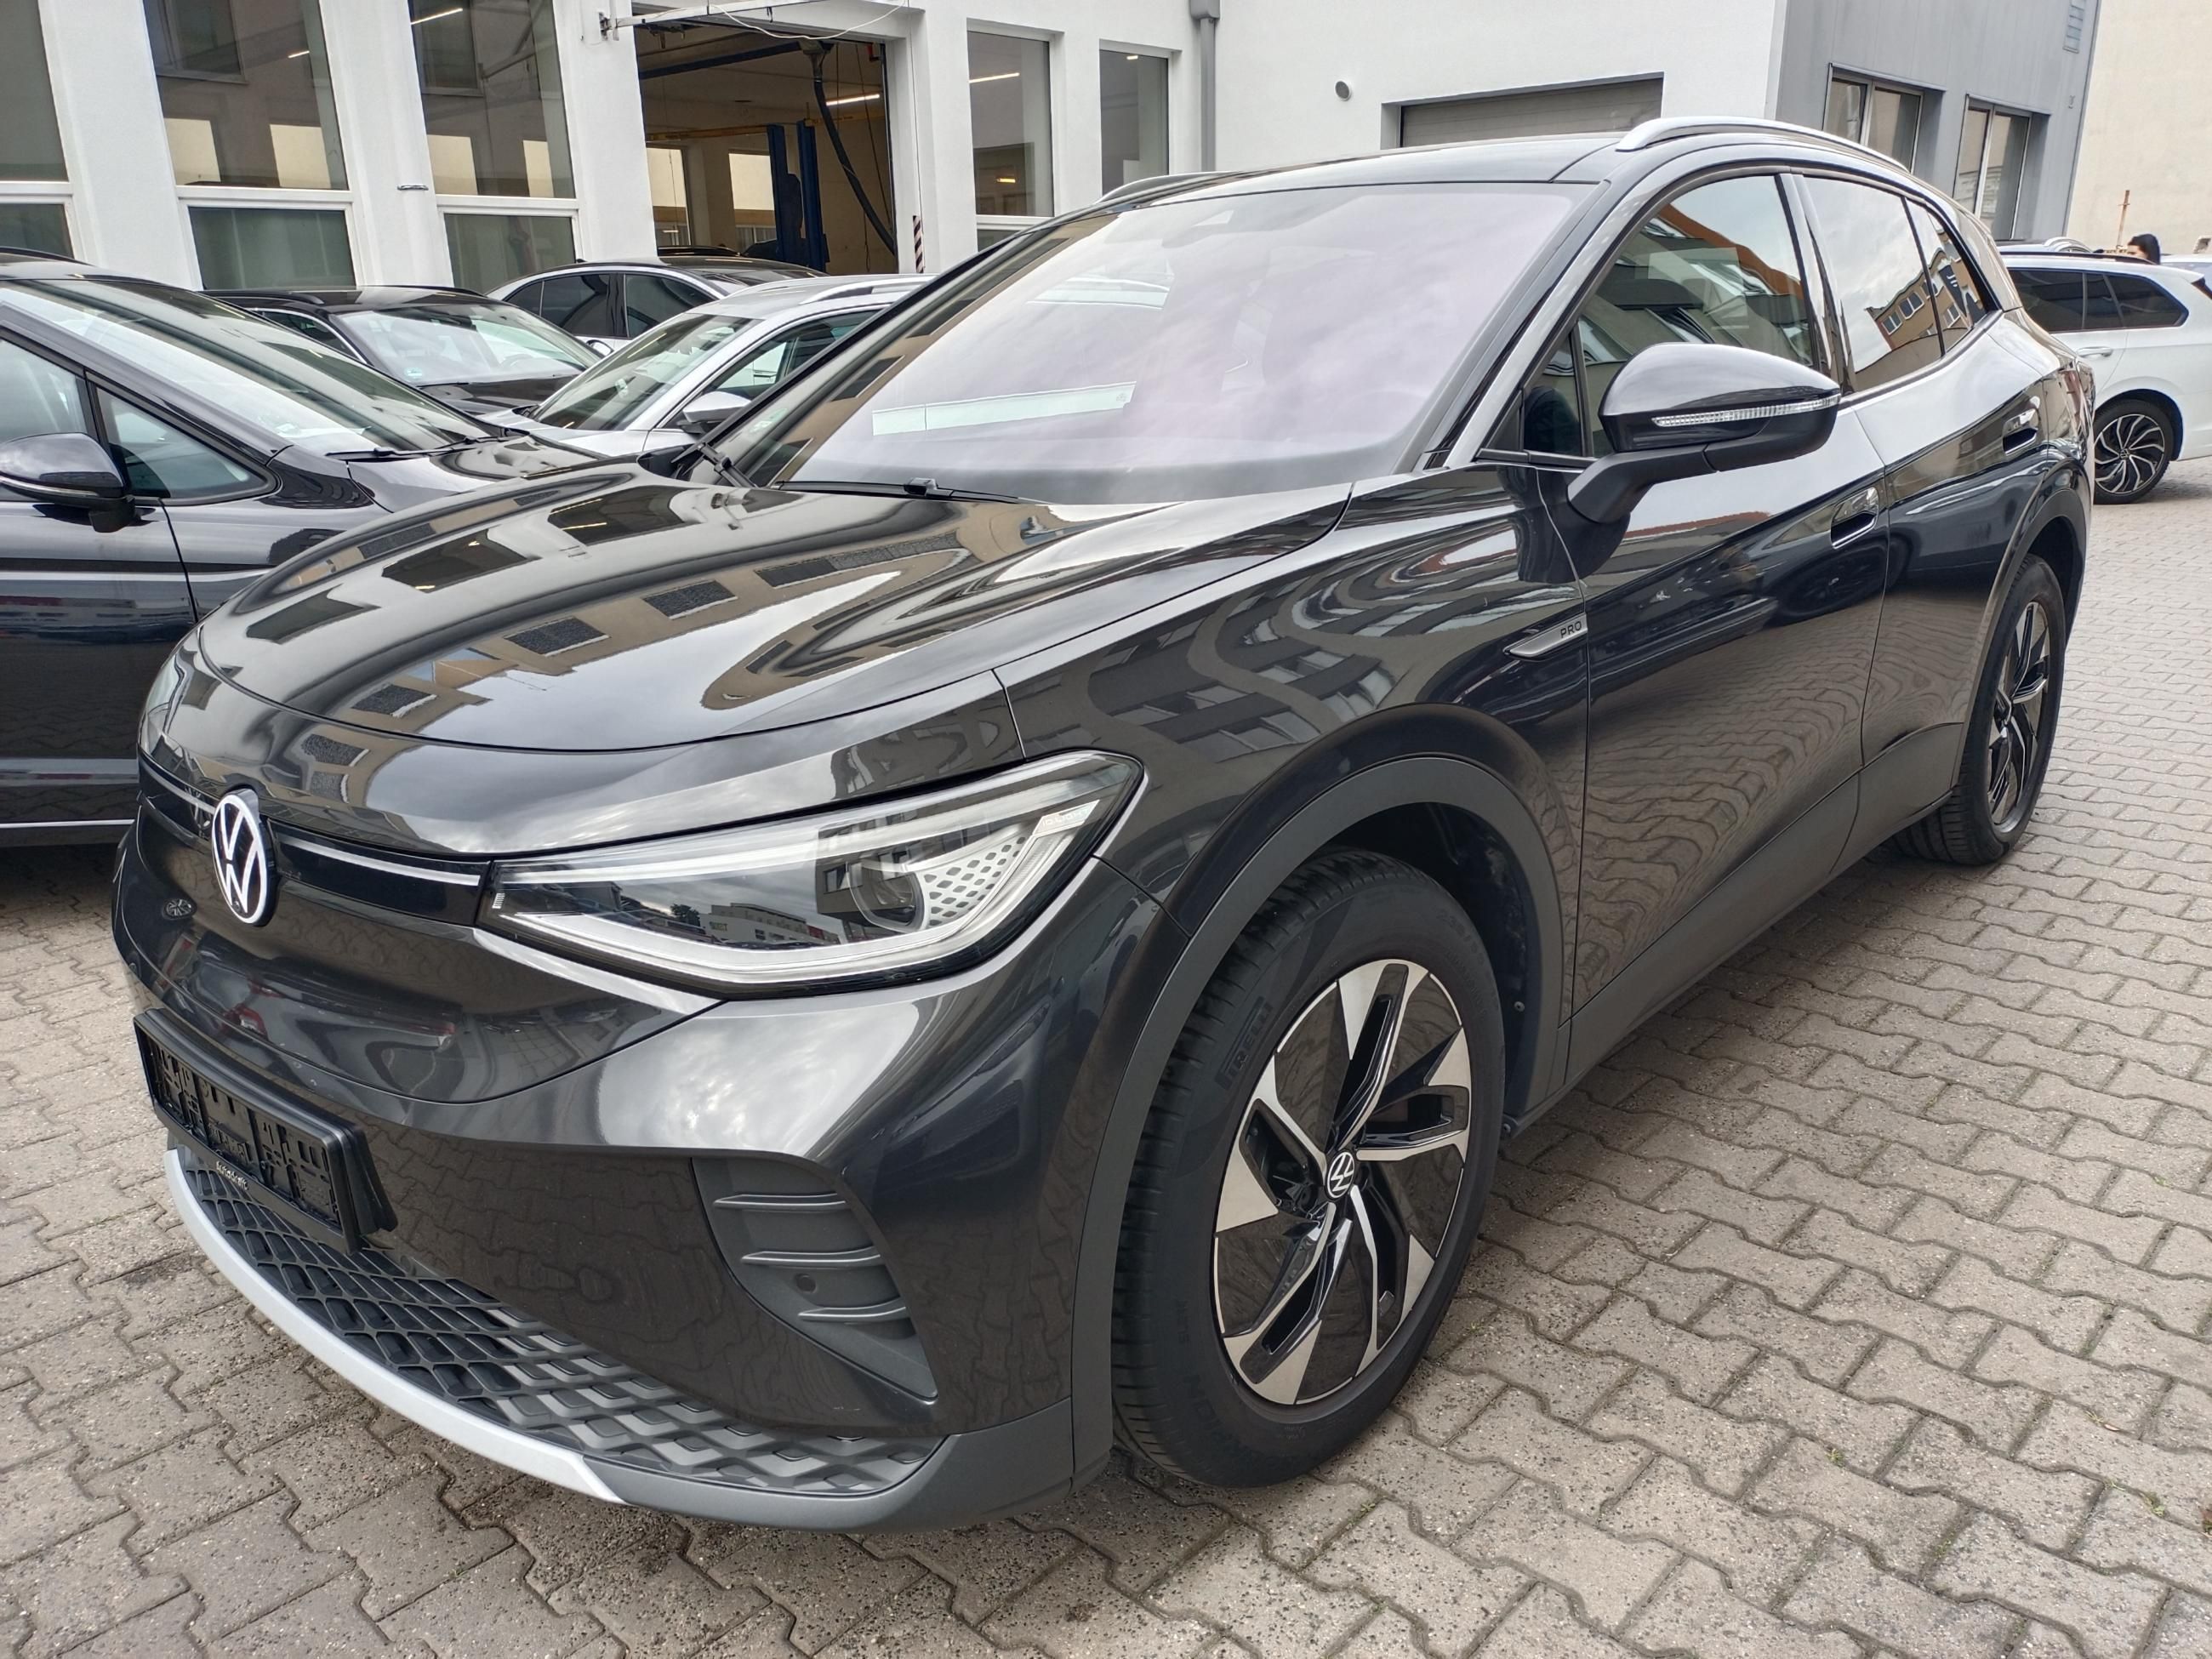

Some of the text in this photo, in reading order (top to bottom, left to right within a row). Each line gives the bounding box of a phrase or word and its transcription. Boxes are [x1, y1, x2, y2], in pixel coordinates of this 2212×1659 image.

[1559, 621, 1582, 639] PRO
[214, 795, 266, 923] VW
[1214, 996, 1274, 1090] PIRELLI
[1327, 1152, 1354, 1198] VW
